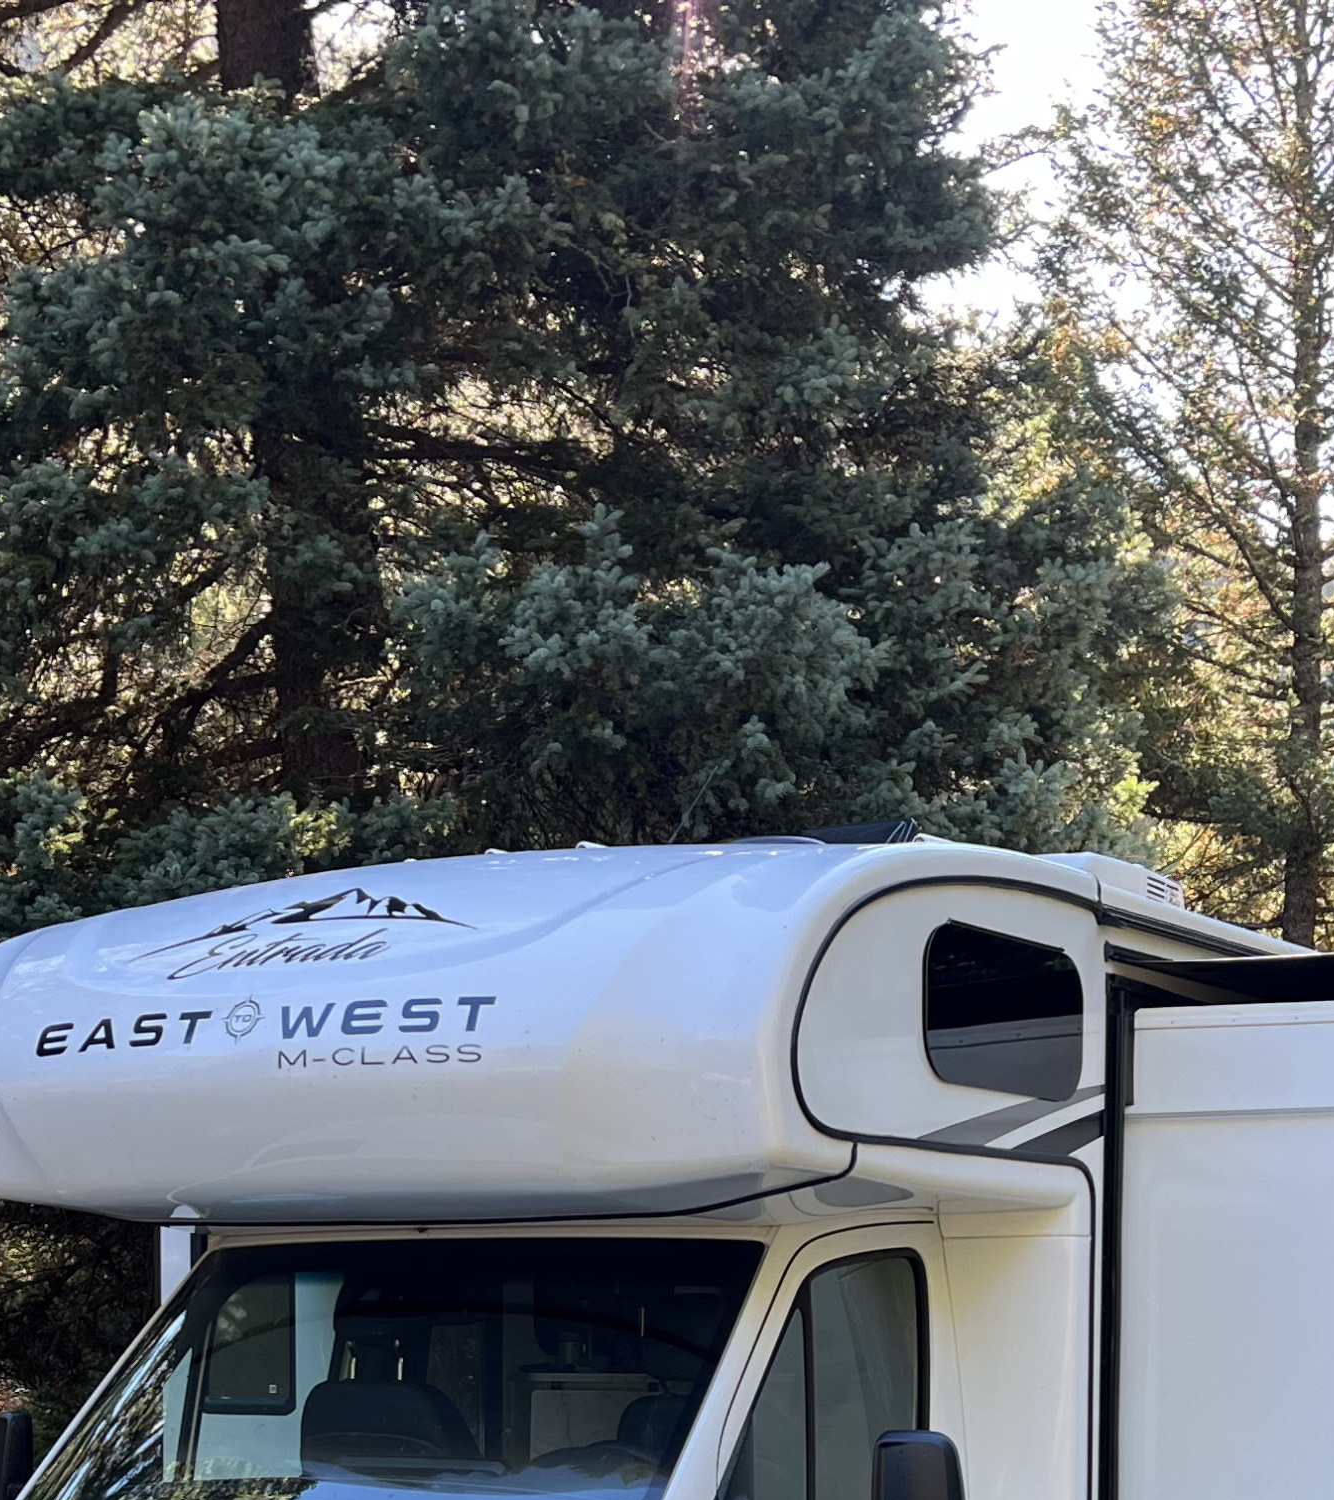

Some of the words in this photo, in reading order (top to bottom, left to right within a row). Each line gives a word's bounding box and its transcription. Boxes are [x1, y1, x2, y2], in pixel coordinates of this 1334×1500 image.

[166, 928, 390, 980] Entrada
[36, 1010, 213, 1057] EAST
[280, 995, 497, 1040] WEST
[278, 1044, 482, 1069] M-CLASS
